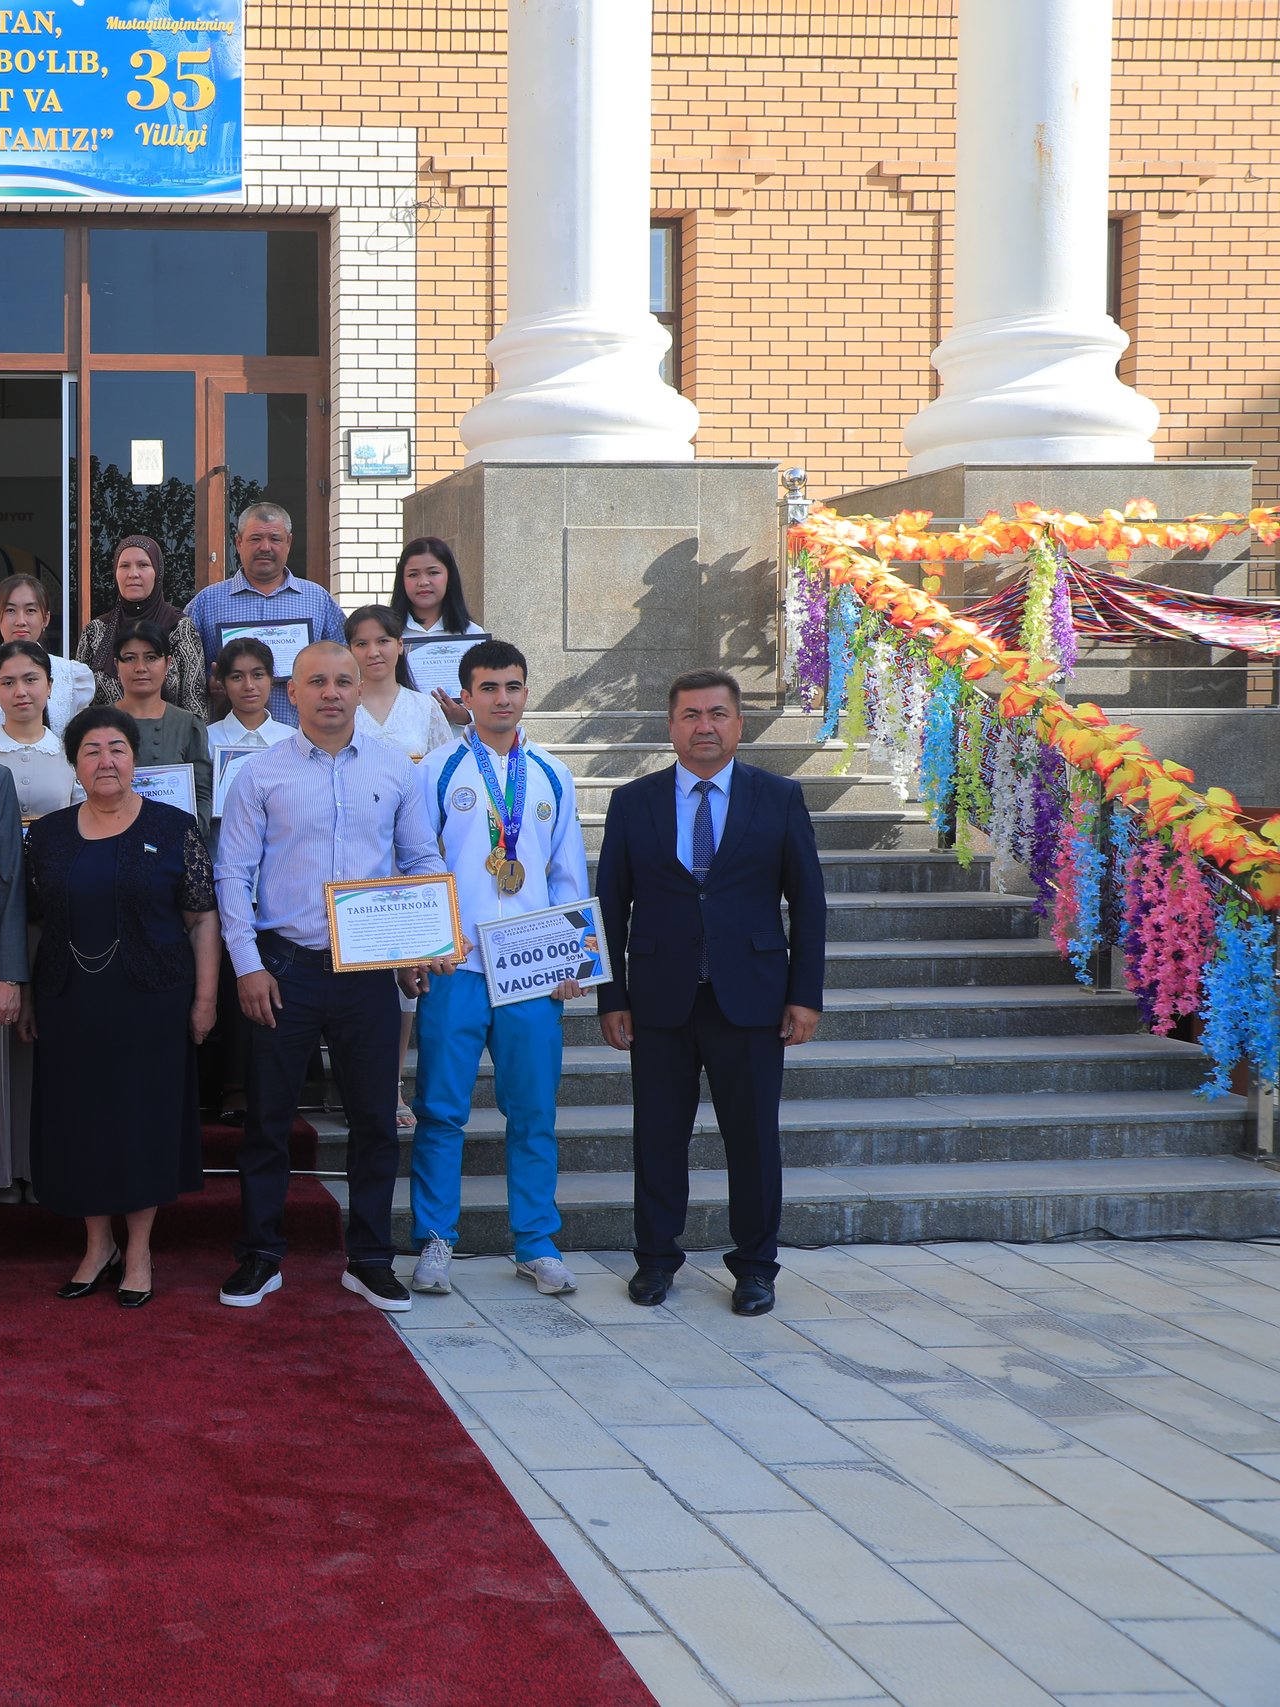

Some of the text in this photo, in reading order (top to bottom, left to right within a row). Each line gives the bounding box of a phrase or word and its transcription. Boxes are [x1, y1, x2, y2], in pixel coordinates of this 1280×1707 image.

[106, 16, 235, 35] Mustaqilligimizning
[126, 47, 216, 111] 35
[23, 88, 63, 113] VA
[134, 122, 208, 153] Yilligi
[347, 900, 438, 915] TASHAKKURNOMA
[496, 956, 507, 969] 4
[510, 948, 543, 967] 000
[547, 940, 580, 959] 000
[497, 967, 575, 994] VAUCHER
